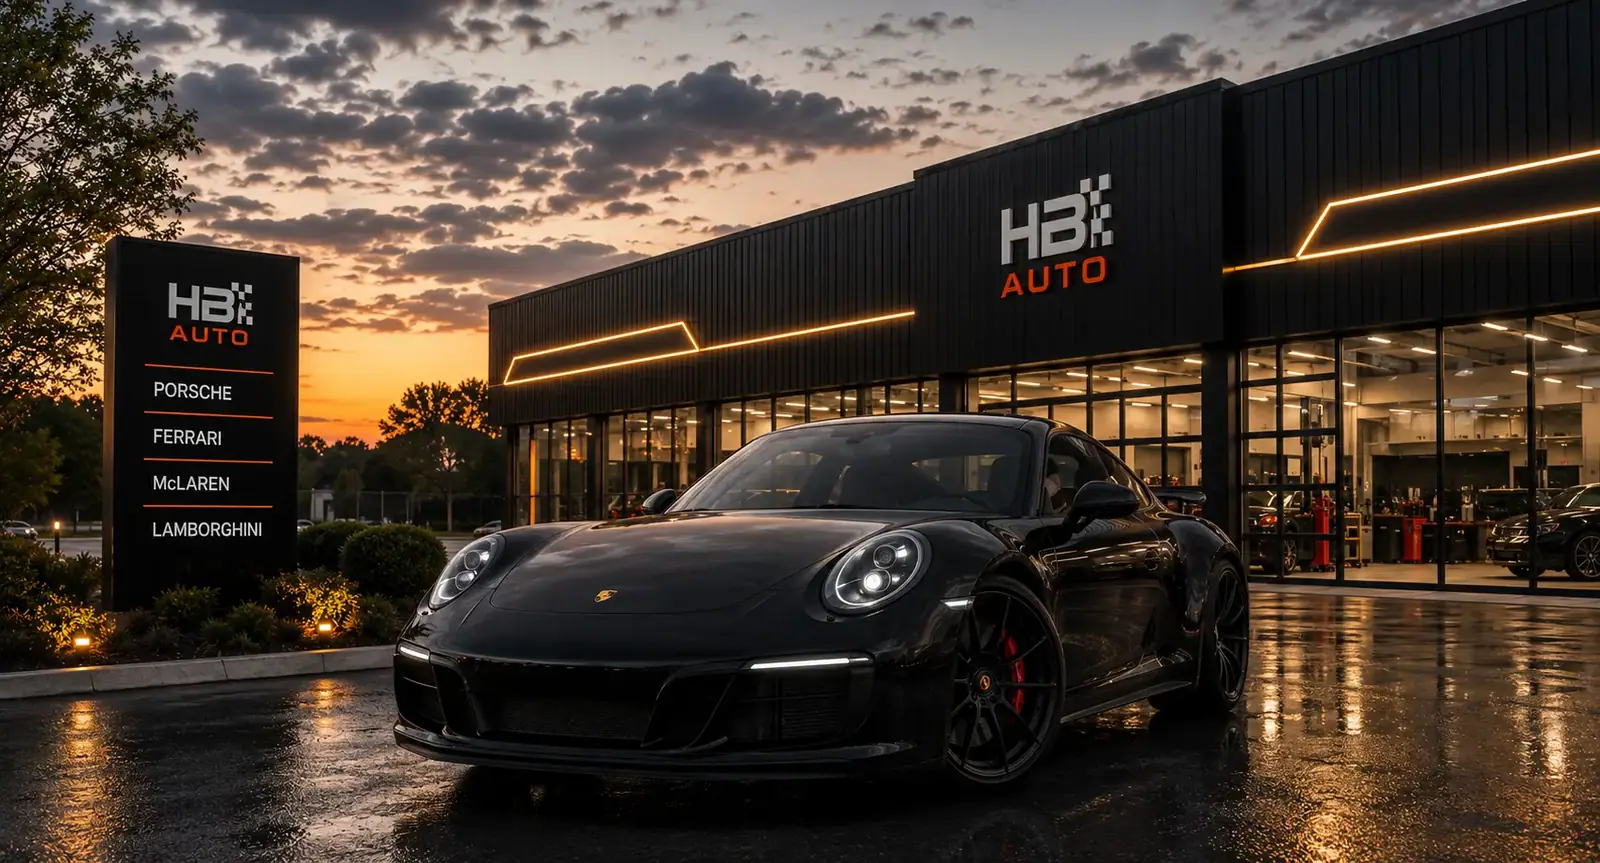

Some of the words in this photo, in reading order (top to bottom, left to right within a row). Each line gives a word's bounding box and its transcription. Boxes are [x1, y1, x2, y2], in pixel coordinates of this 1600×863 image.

[1001, 192, 1088, 266] HB
[1000, 255, 1107, 299] AUTO
[168, 282, 236, 324] HB
[169, 324, 249, 346] AUTO
[153, 381, 232, 401] PORSCHE
[153, 428, 222, 446] FERRARI
[153, 475, 230, 492] McLAREN
[152, 521, 263, 537] LAMBORGHINI
